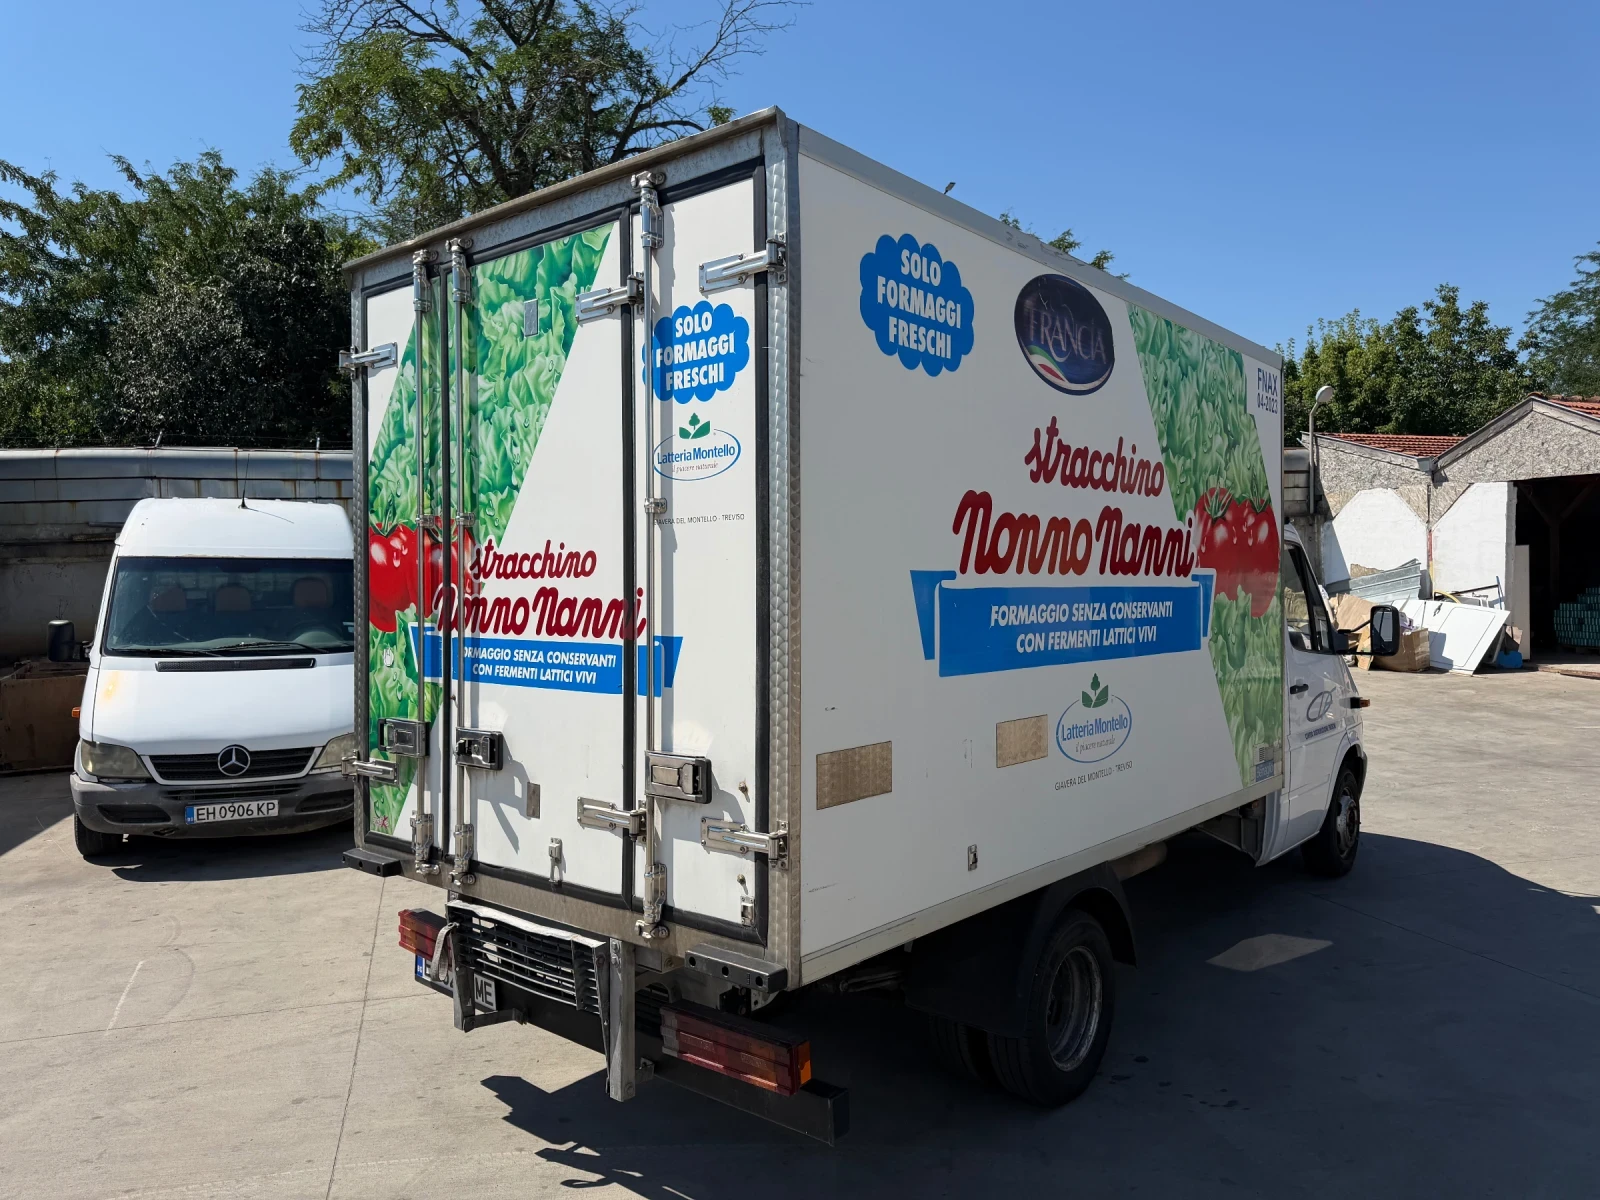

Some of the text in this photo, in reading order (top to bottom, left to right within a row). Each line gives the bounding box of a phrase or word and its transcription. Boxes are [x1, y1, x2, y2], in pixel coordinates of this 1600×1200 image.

[901, 248, 942, 287] SOLO
[877, 275, 962, 329] FORMAGGI
[675, 311, 713, 338] SOLO
[888, 316, 952, 359] FRESCHI
[656, 332, 735, 368] FORMAGGI
[665, 362, 725, 391] FRESCHI
[1257, 367, 1278, 397] FNAX
[1257, 392, 1278, 414] 04-2023
[657, 443, 736, 465] Latteria Montello
[1024, 415, 1165, 497] stracchino
[687, 515, 718, 524] MONTELLO
[722, 513, 745, 521] TREVISO
[952, 489, 1195, 578] Nonno Nanni
[469, 538, 597, 580] stracchino
[532, 586, 647, 641] Nanni
[990, 601, 1173, 627] FORMAGGIO SENZA CONSERVANTI
[1016, 625, 1157, 653] CON FERMENTI LATTICI VIVI
[464, 645, 616, 668] ORMAGGIO SENZA CONSERVANTI
[472, 664, 597, 684] CON FERMENTI LATTICI VIVI
[1061, 714, 1128, 741] Latteria Montello
[1054, 778, 1077, 791] GIAVERA
[1077, 774, 1087, 785] DEL
[1087, 767, 1113, 782] MONTELLO
[1115, 760, 1133, 772] TREVISO
[196, 802, 276, 822] EH 0906 KP
[474, 976, 494, 1007] ME
